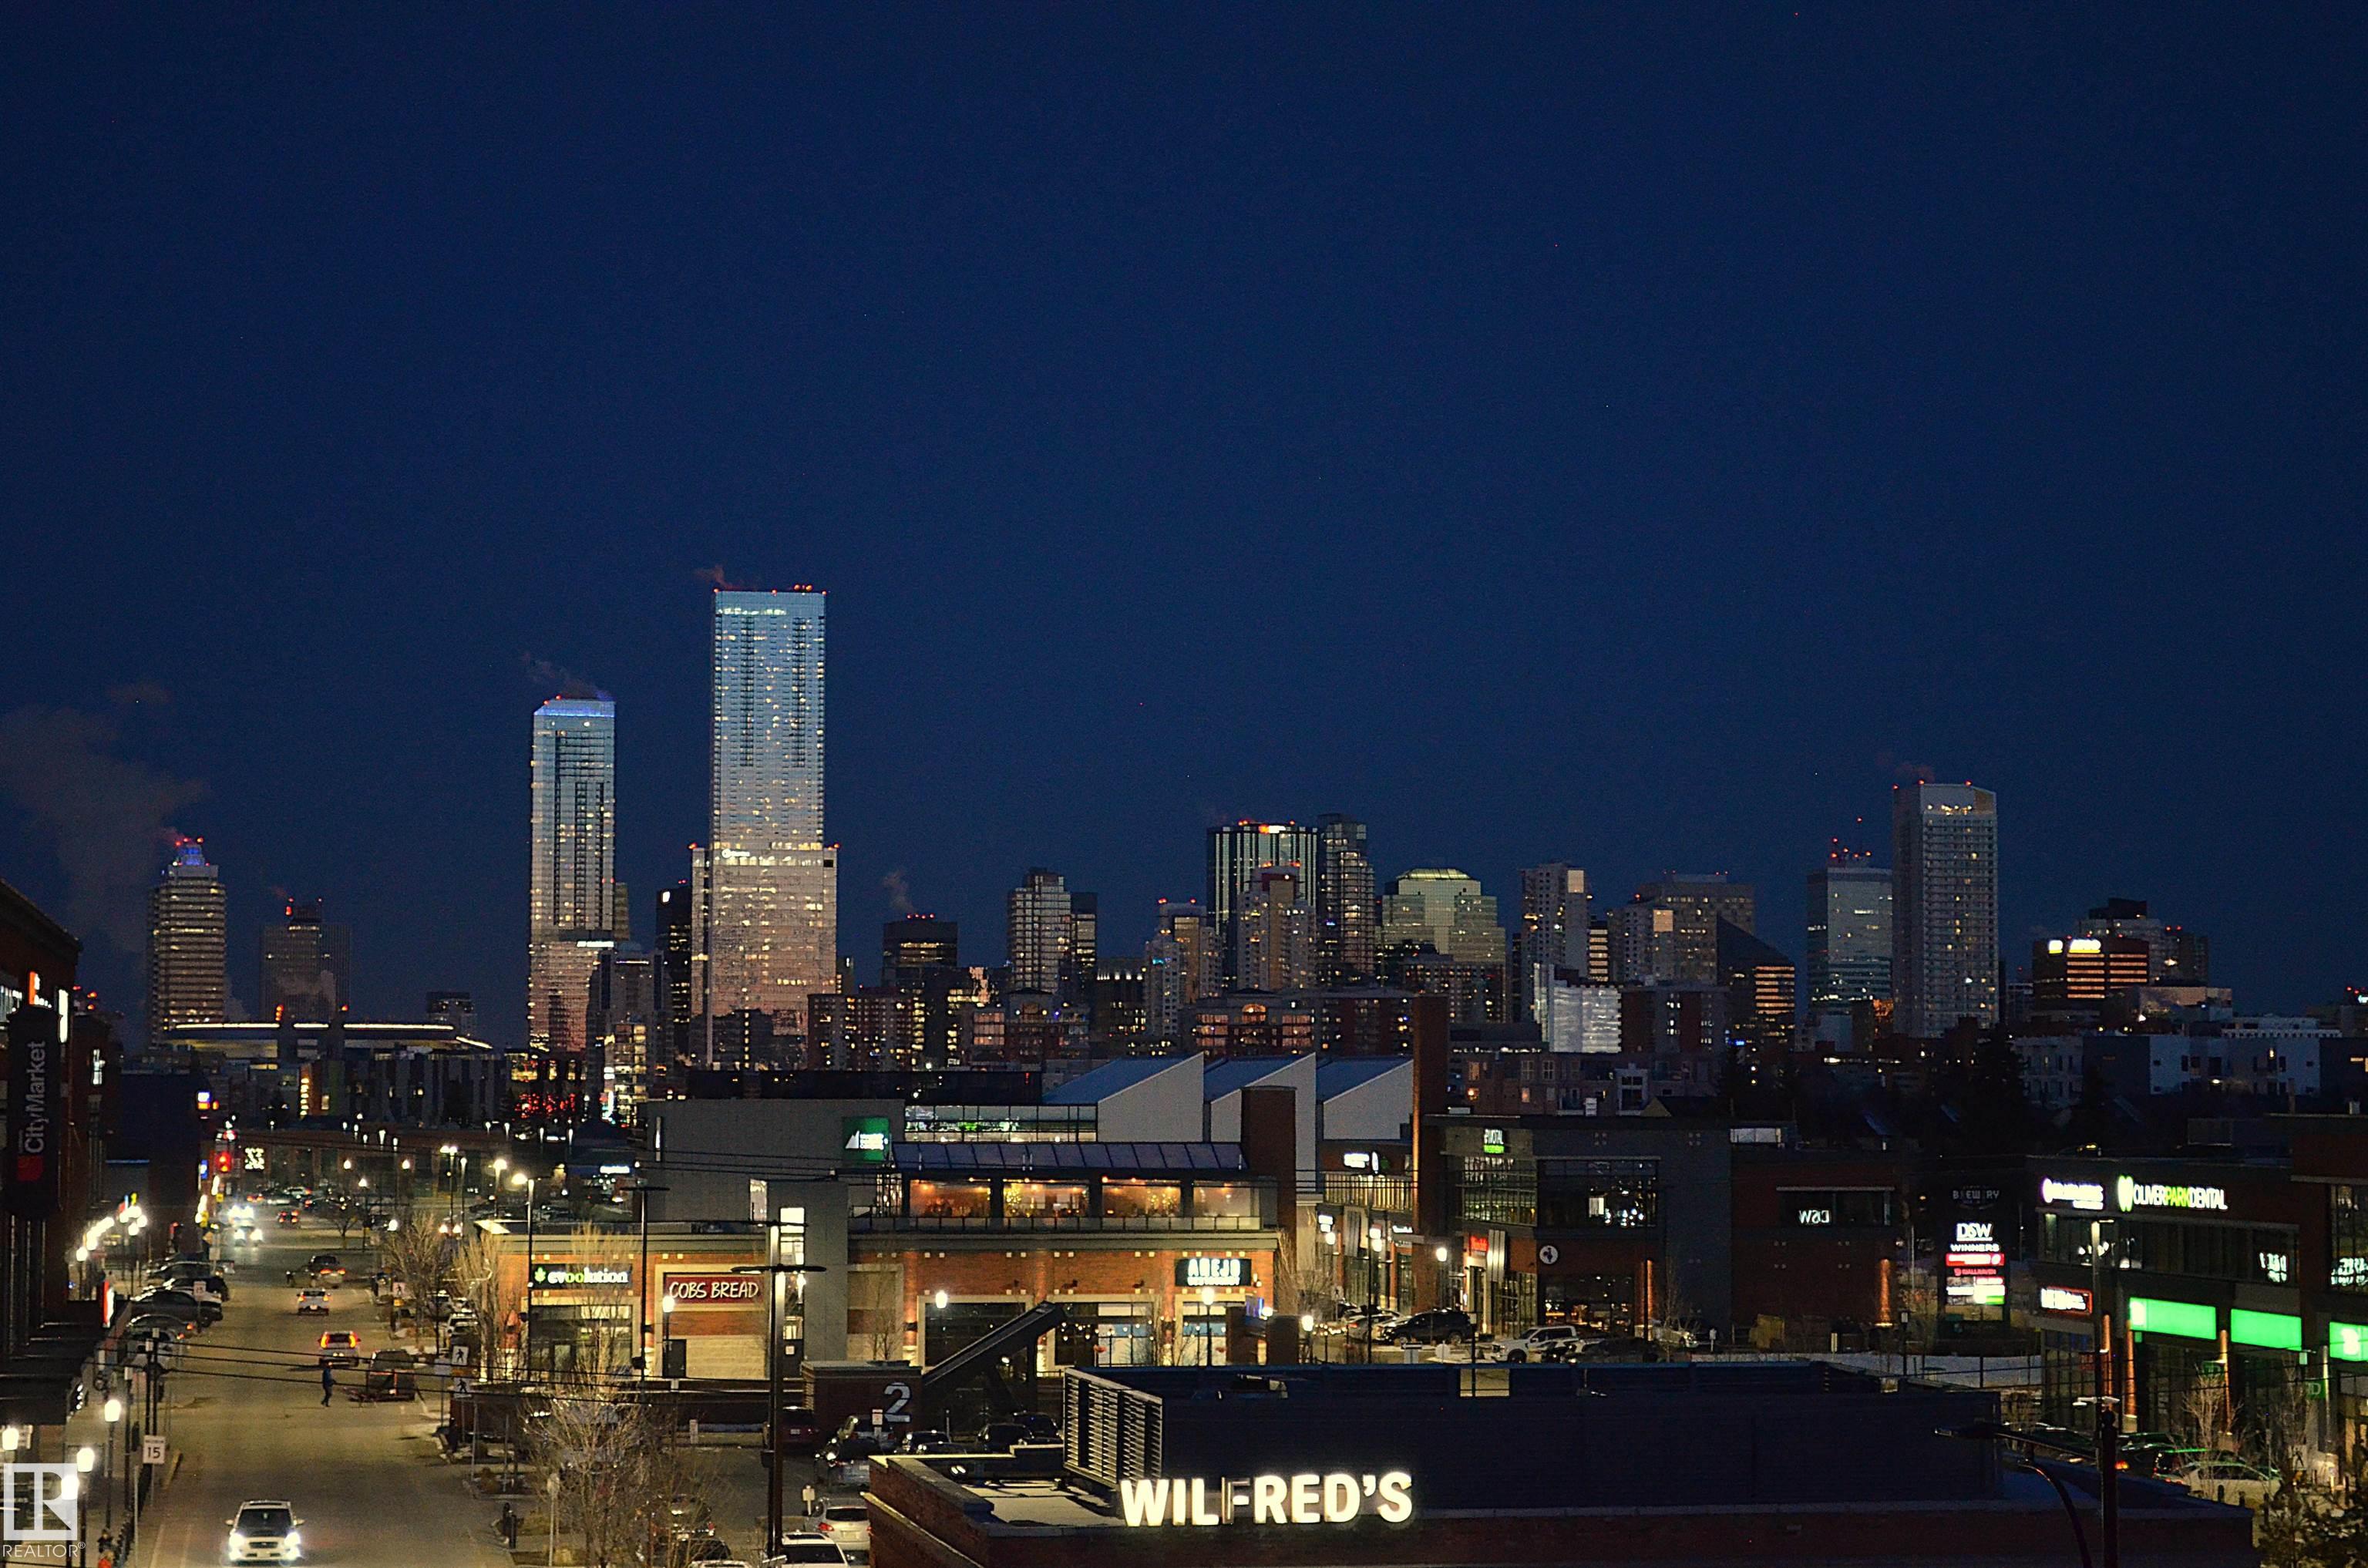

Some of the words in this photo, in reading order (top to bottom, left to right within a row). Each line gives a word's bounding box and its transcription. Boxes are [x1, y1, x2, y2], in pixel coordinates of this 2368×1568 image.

[24, 1041, 49, 1154] CityMarket
[1956, 1223, 1992, 1238] DSW
[1950, 1243, 2000, 1252] WINNERS
[669, 1281, 707, 1298] COBS
[710, 1281, 758, 1298] BREAD
[884, 1382, 910, 1422] 2
[148, 1446, 160, 1459] 15
[1120, 1472, 1413, 1526] WILFRED'S
